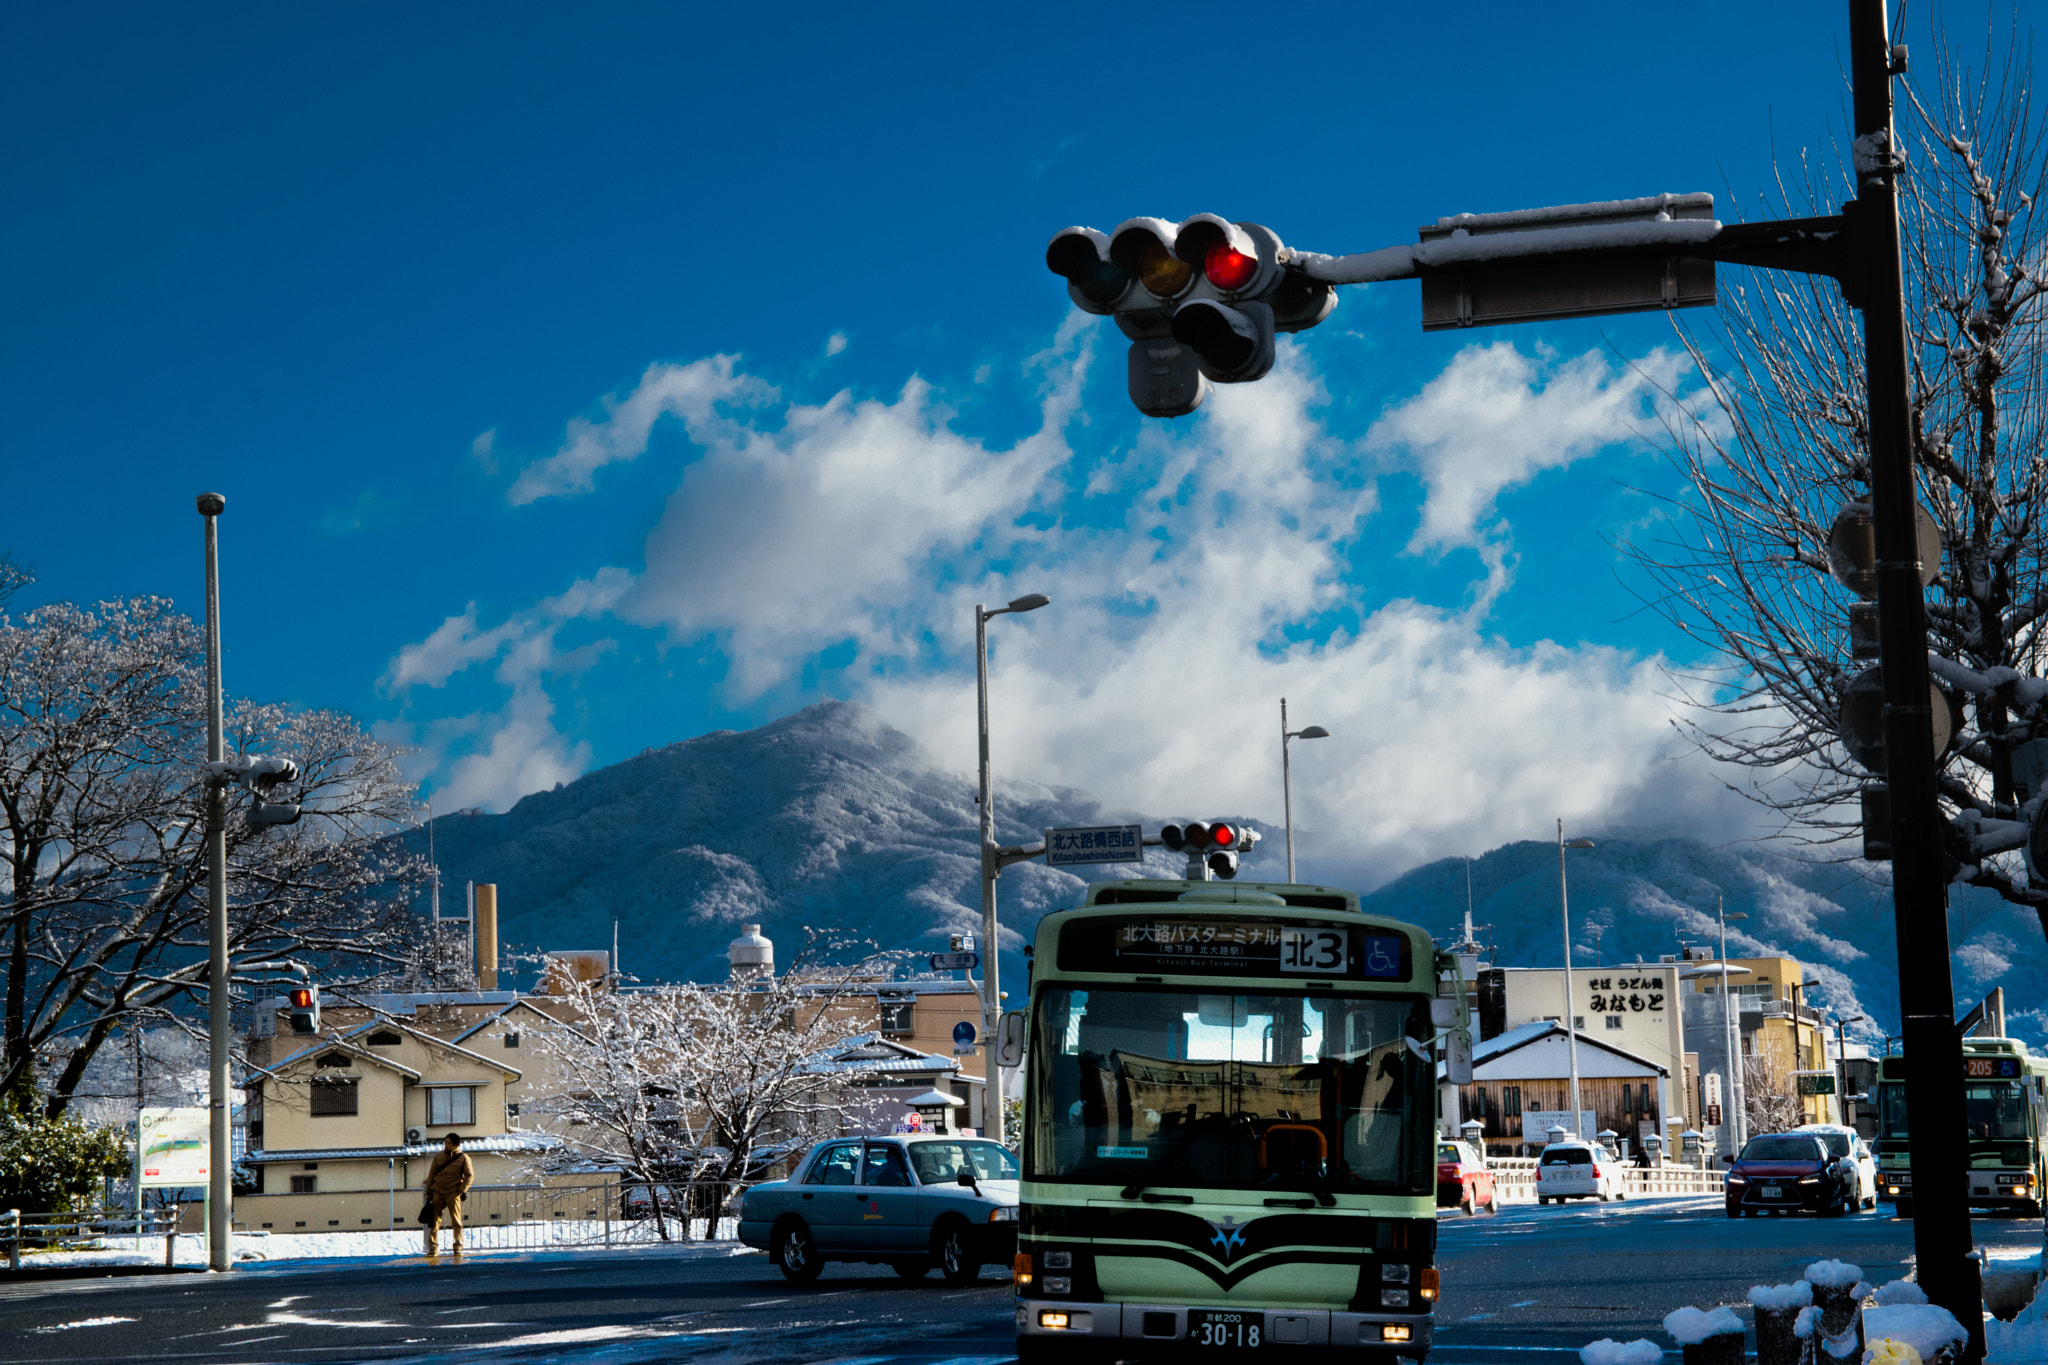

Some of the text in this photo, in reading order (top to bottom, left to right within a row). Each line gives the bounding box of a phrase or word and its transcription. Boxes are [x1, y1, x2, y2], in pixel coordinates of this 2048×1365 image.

[1052, 830, 1135, 850] 北大路橋西詰
[1052, 850, 1137, 863] Kitaojibashinishizume
[1123, 923, 1280, 945] 北大路バスターミナル
[1285, 932, 1343, 969] 北3
[1589, 977, 1664, 990] そば うどん処
[1590, 993, 1664, 1013] みなもと
[1969, 1061, 1992, 1076] 205
[1200, 1322, 1260, 1348] 30-18
